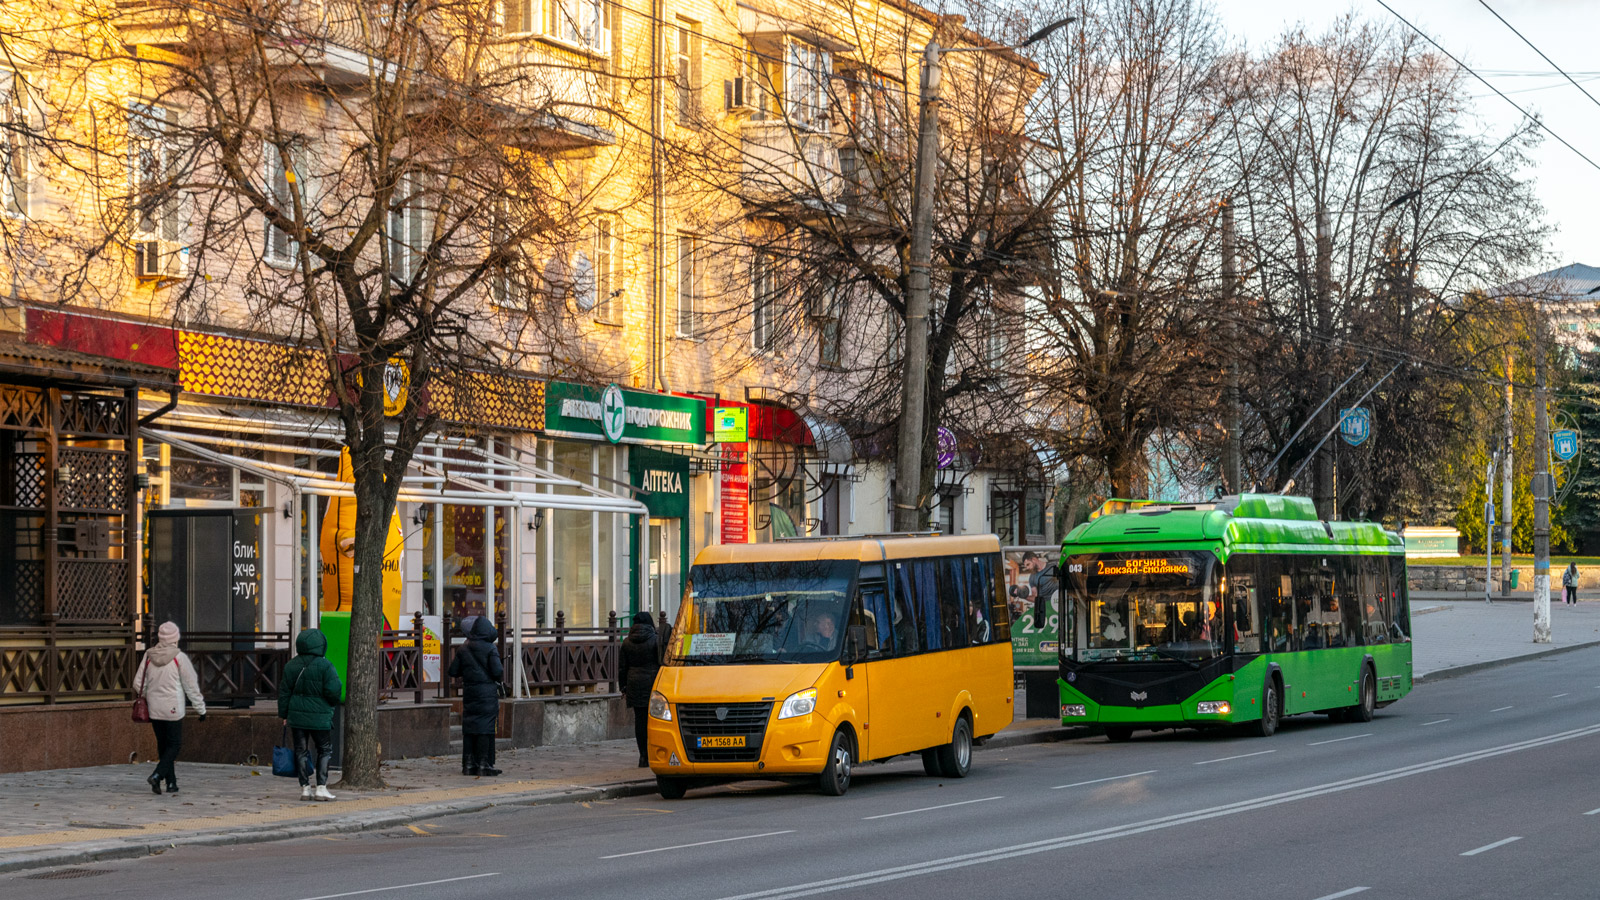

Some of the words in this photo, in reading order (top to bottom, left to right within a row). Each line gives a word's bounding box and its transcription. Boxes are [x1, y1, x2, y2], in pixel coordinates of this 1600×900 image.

[625, 406, 692, 430] ПОДОРОЖНИК
[642, 469, 683, 494] АПТЕКА
[233, 540, 256, 558] бли-
[234, 563, 255, 577] жче
[1068, 564, 1083, 573] 043
[1097, 560, 1105, 575] 2
[1104, 565, 1189, 575] ВОКЗАЛ-СМОЛЯНКА
[1125, 559, 1168, 568] БОГУНІЯ
[239, 581, 256, 600] тут
[702, 738, 713, 746] AM
[715, 738, 731, 746] 1568
[733, 737, 743, 746] AA
